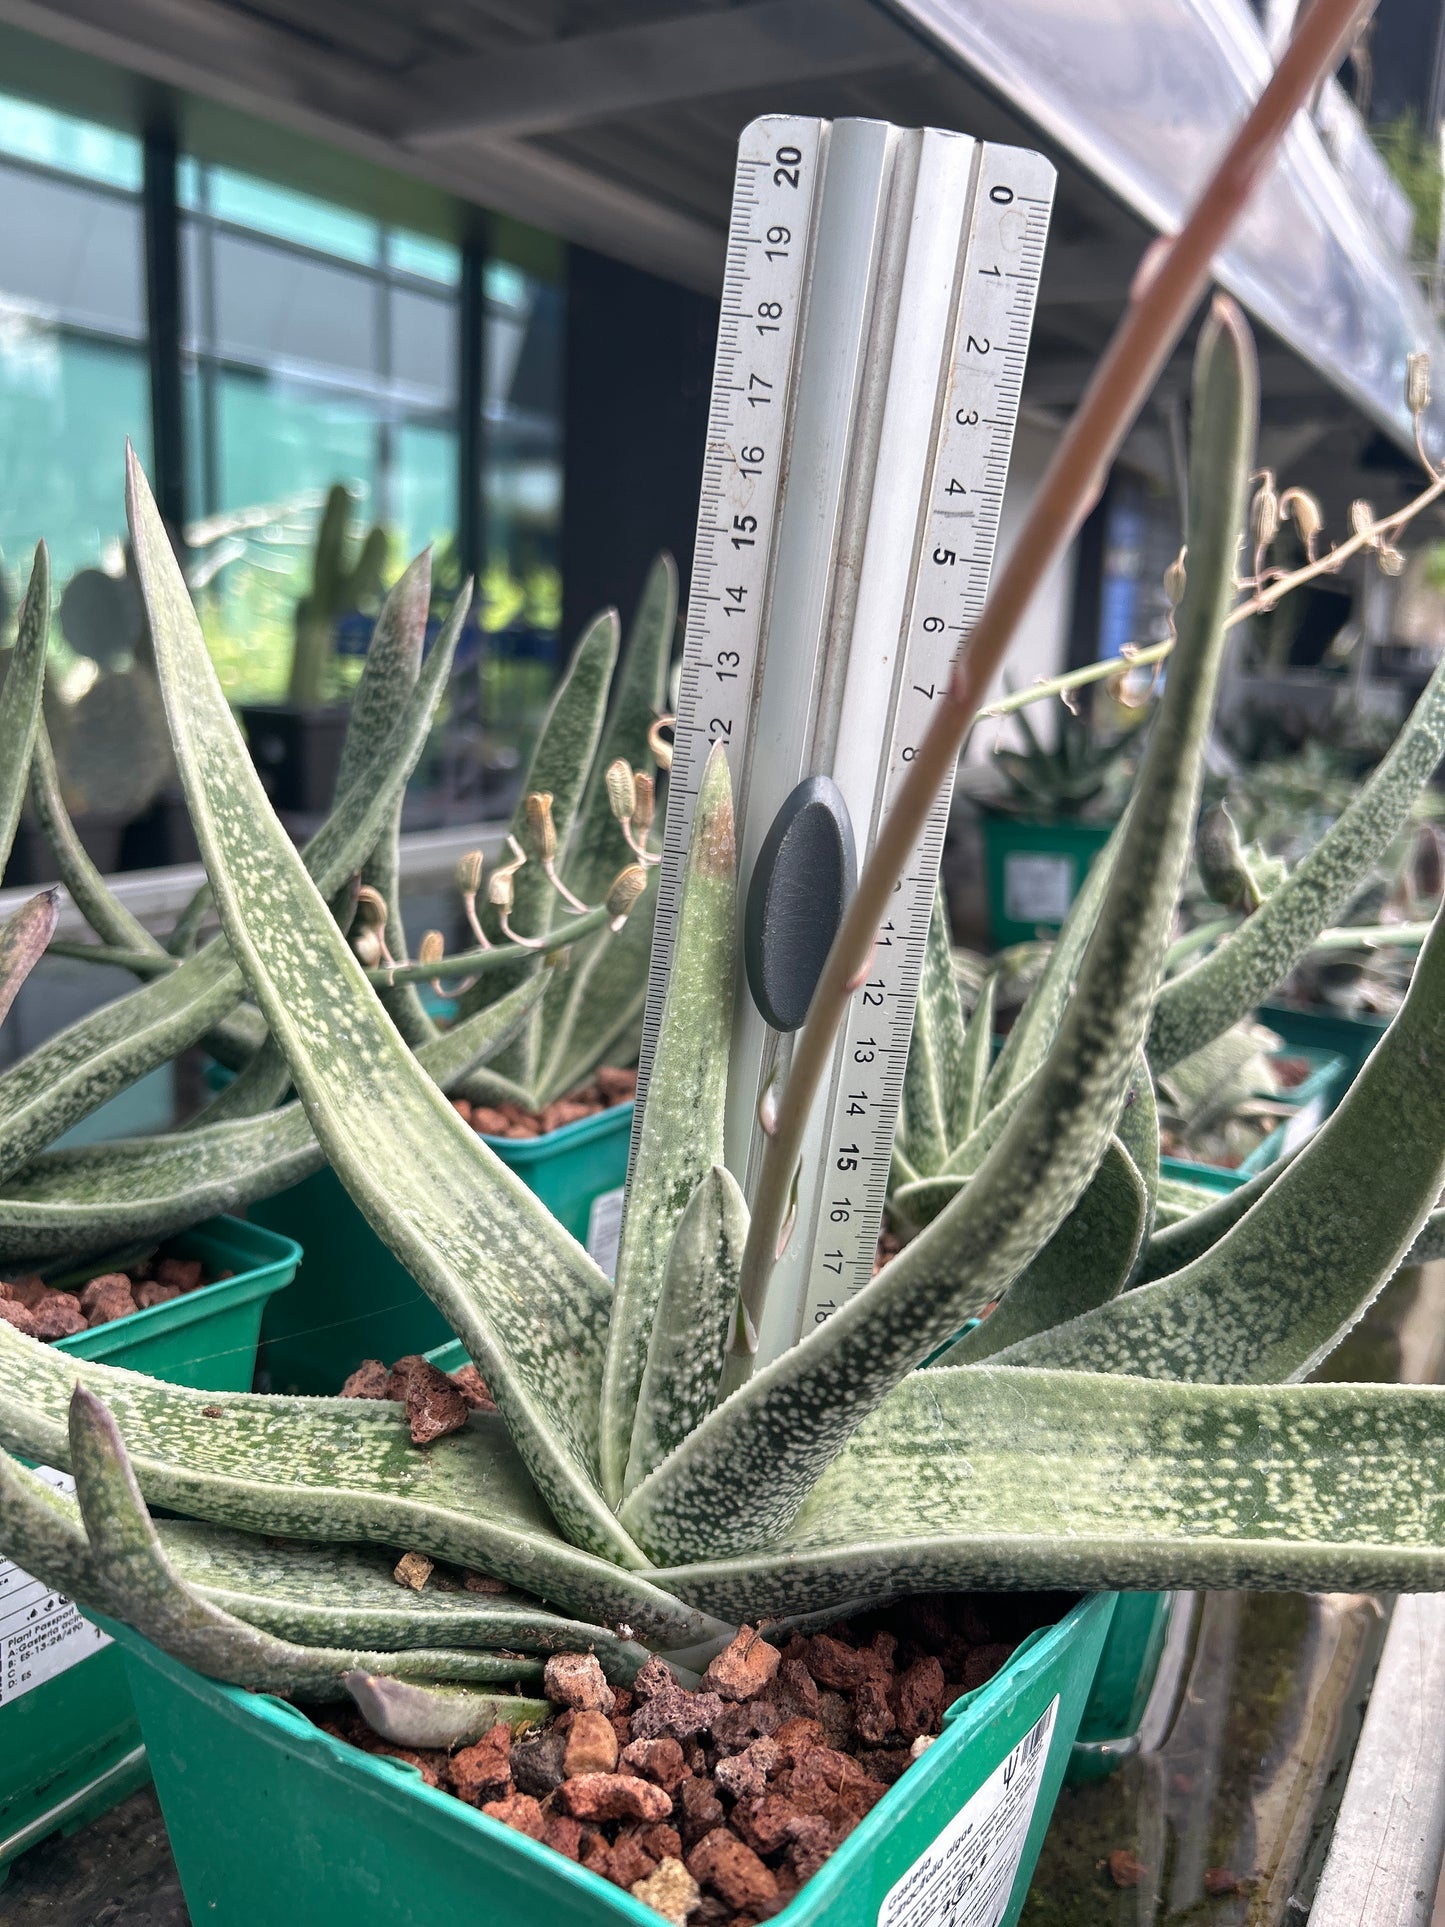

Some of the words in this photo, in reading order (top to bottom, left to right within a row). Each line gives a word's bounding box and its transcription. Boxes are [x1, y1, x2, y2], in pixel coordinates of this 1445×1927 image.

[773, 146, 802, 189] 20
[989, 185, 1014, 205] 0
[764, 226, 791, 262] 19
[978, 265, 1001, 277] 1
[755, 302, 783, 336] 18
[966, 335, 990, 355] 2
[747, 373, 773, 408] 17
[955, 408, 979, 426] 3
[739, 446, 765, 479] 16
[944, 478, 967, 496] 4
[730, 515, 758, 550] 15
[932, 547, 956, 566] 5
[723, 585, 748, 617] 14
[922, 616, 945, 633] 6
[715, 651, 740, 682] 13
[913, 684, 935, 700] 7
[874, 921, 895, 946] 11
[862, 979, 886, 1007] 12
[854, 1037, 877, 1063] 13
[845, 1090, 869, 1117] 14
[836, 1143, 860, 1171] 15
[829, 1197, 852, 1223] 16
[822, 1249, 844, 1275] 17
[8, 1630, 32, 1648] Plant
[35, 1607, 75, 1634] Passport
[21, 1671, 32, 1682] ES
[888, 1856, 932, 1910] Gasteria
